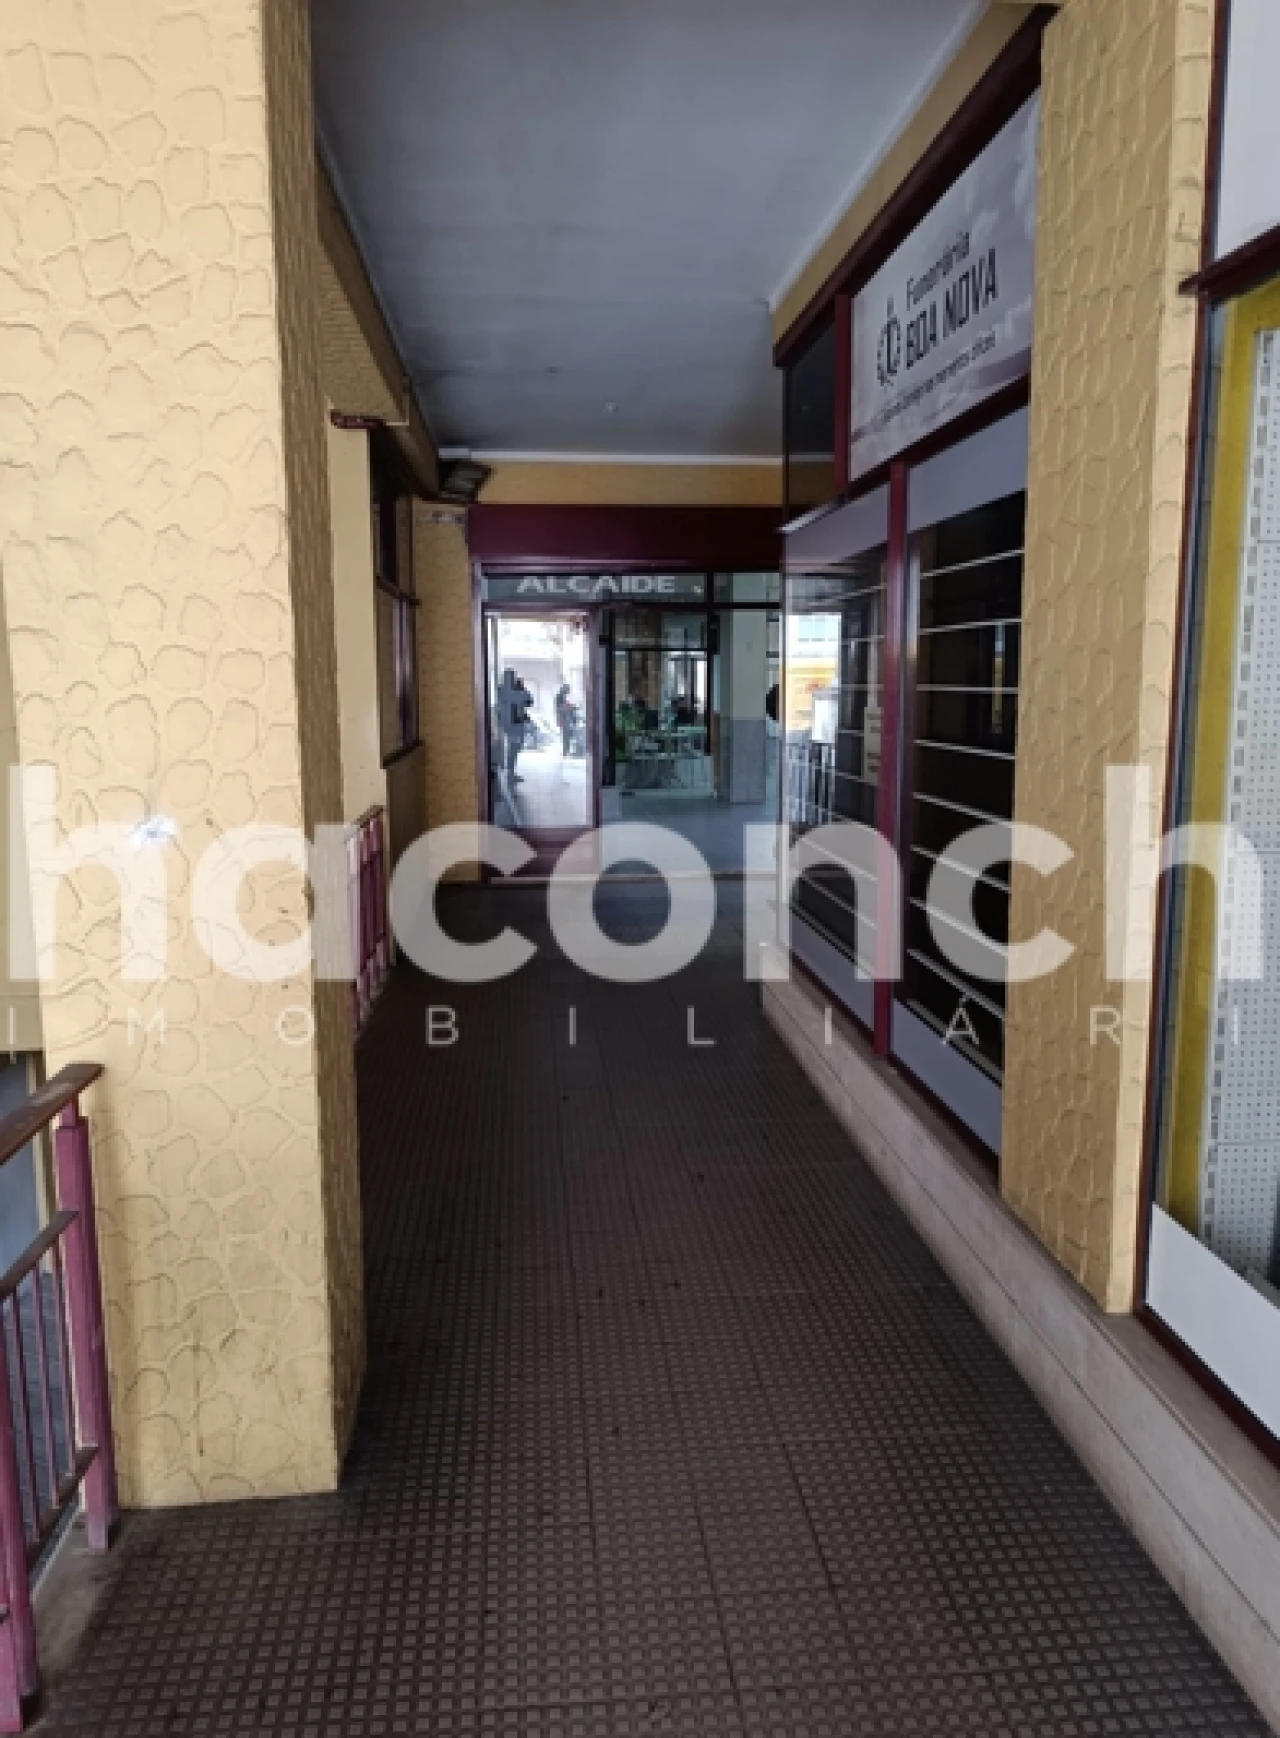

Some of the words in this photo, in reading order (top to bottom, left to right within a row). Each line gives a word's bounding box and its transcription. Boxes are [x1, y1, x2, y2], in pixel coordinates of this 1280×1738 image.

[906, 301, 937, 370] BOA
[943, 246, 999, 340] NOVA
[516, 575, 676, 593] ALCAIDE
